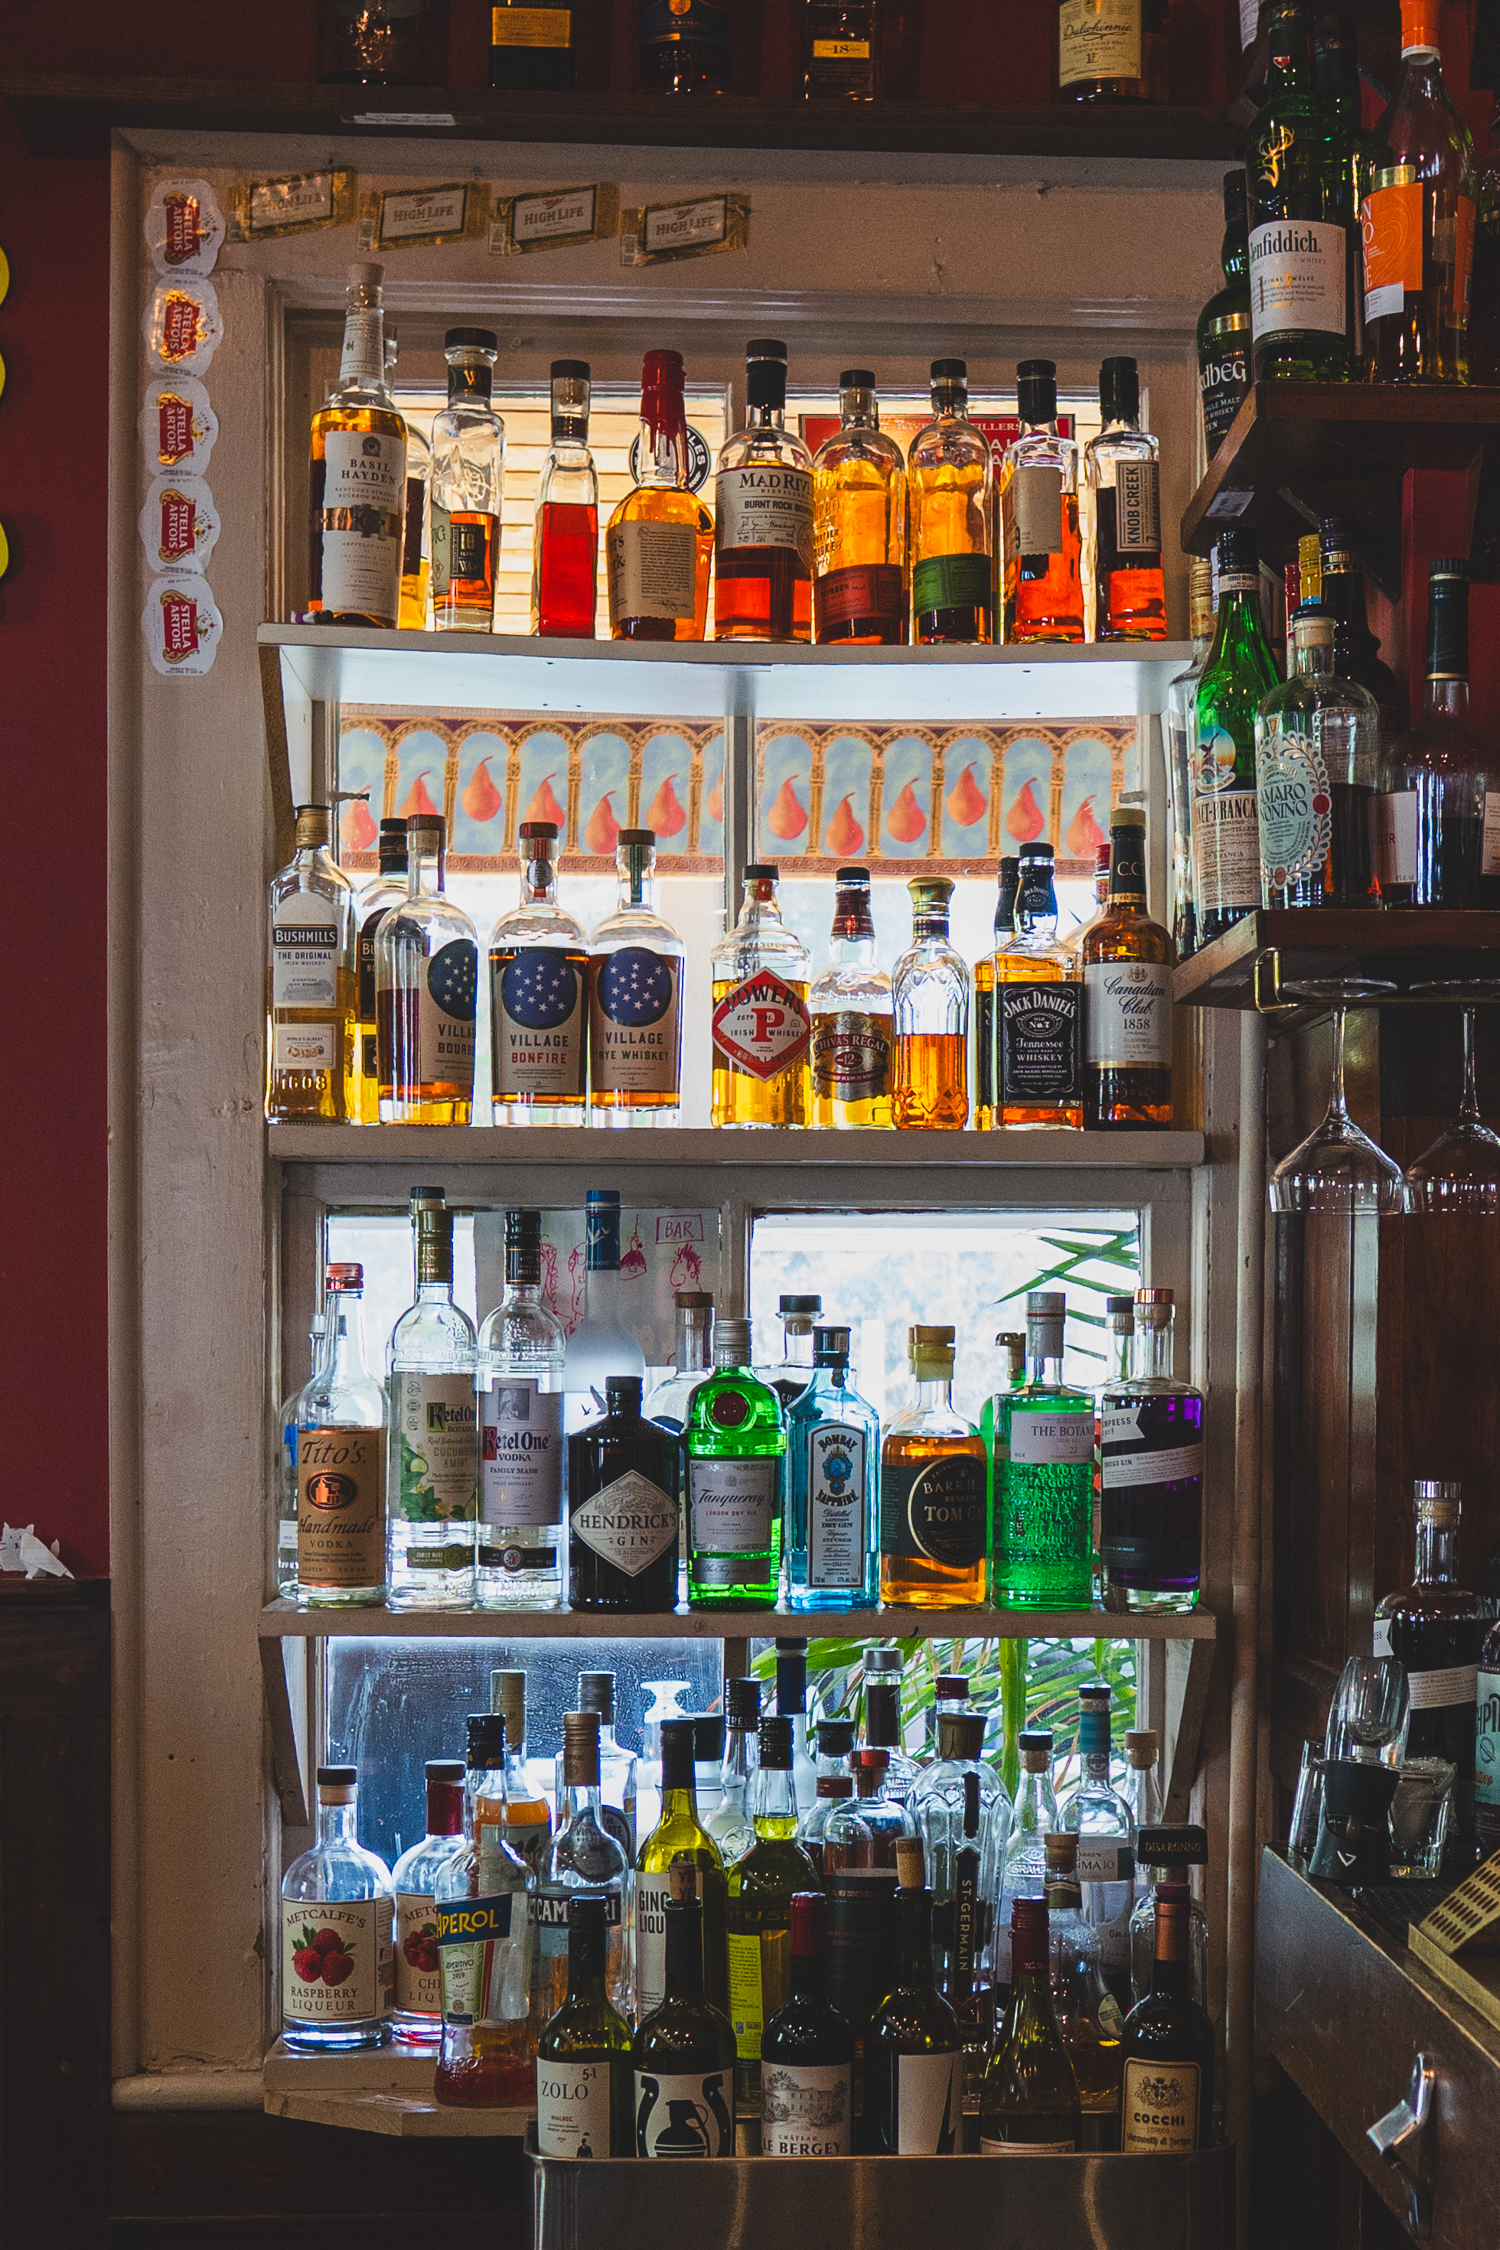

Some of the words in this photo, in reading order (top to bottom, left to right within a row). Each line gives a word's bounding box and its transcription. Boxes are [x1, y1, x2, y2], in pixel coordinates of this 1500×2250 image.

[831, 44, 847, 54] 18
[393, 209, 426, 222] HIGH
[427, 205, 455, 218] LIFE
[524, 211, 557, 225] HIGH
[557, 206, 583, 220] LIFE
[173, 207, 182, 251] ARTOIS
[656, 222, 687, 236] HIGH
[170, 304, 181, 349] ARTOIS
[181, 305, 192, 349] STELLA
[167, 406, 176, 451] ARTOIS
[177, 406, 186, 451] STELLA
[350, 459, 391, 474] BASIL
[341, 470, 398, 487] HAYDEN
[1127, 467, 1140, 508] CREEK
[744, 500, 771, 510] BURNT
[772, 500, 793, 511] ROCK
[169, 503, 178, 549] ARTOIS
[178, 504, 188, 548] STELLA
[1128, 511, 1140, 544] KNOB
[170, 604, 181, 649] ARTOIS
[180, 604, 191, 648] STELLA
[275, 931, 337, 944] BUSHMILLS
[278, 952, 293, 960] THE
[295, 952, 333, 961] ORIGINAL
[1104, 976, 1166, 998] Canadian
[724, 984, 804, 1015] POWERS
[1003, 996, 1032, 1018] JACK
[1032, 991, 1077, 1019] DANIEL'S
[751, 1008, 785, 1043] P
[1123, 1018, 1151, 1030] 1858
[510, 1034, 569, 1047] VILLAGE
[605, 1032, 664, 1045] VILLAGE
[730, 1029, 755, 1037] IRISH
[768, 1029, 804, 1039] WHISKEY
[815, 1036, 849, 1053] CHIVAS
[852, 1035, 885, 1053] REGAL
[1016, 1037, 1064, 1049] Tennessee
[511, 1052, 567, 1065] BONFIRE
[599, 1050, 617, 1061] RYE
[621, 1050, 670, 1062] WHISKEY
[843, 1053, 855, 1065] 12
[1016, 1054, 1064, 1062] WHISKEY
[664, 1219, 694, 1239] BAR
[1031, 1424, 1056, 1437] THE
[482, 1429, 520, 1457] Ketel
[520, 1431, 550, 1452] One
[818, 1434, 858, 1453] BOMBAY
[498, 1453, 533, 1462] VODKA
[516, 1467, 539, 1475] MADE
[923, 1480, 963, 1495] BARR
[698, 1489, 766, 1507] Tanqueray
[815, 1488, 861, 1507] SAPPHIRE
[580, 1512, 677, 1529] HENDRICK'S
[923, 1505, 963, 1522] TOM
[299, 1514, 375, 1535] Handmade
[310, 1540, 354, 1549] VODKA
[617, 1536, 650, 1546] GIN
[1145, 1841, 1202, 1853] DISARONNO
[287, 1909, 367, 1929] METCALFE'S
[436, 1909, 500, 1938] APEROL
[959, 1880, 972, 1970] ST-GERMAIN
[291, 1986, 359, 1999] RASPBERRY
[292, 1999, 356, 2012] LIQUEUR
[541, 2080, 589, 2100] ZOLO
[551, 2114, 574, 2123] MALBEC
[1134, 2112, 1185, 2126] COCCHI
[778, 2134, 818, 2142] CHÂTEAU
[780, 2141, 842, 2155] BERGEY
